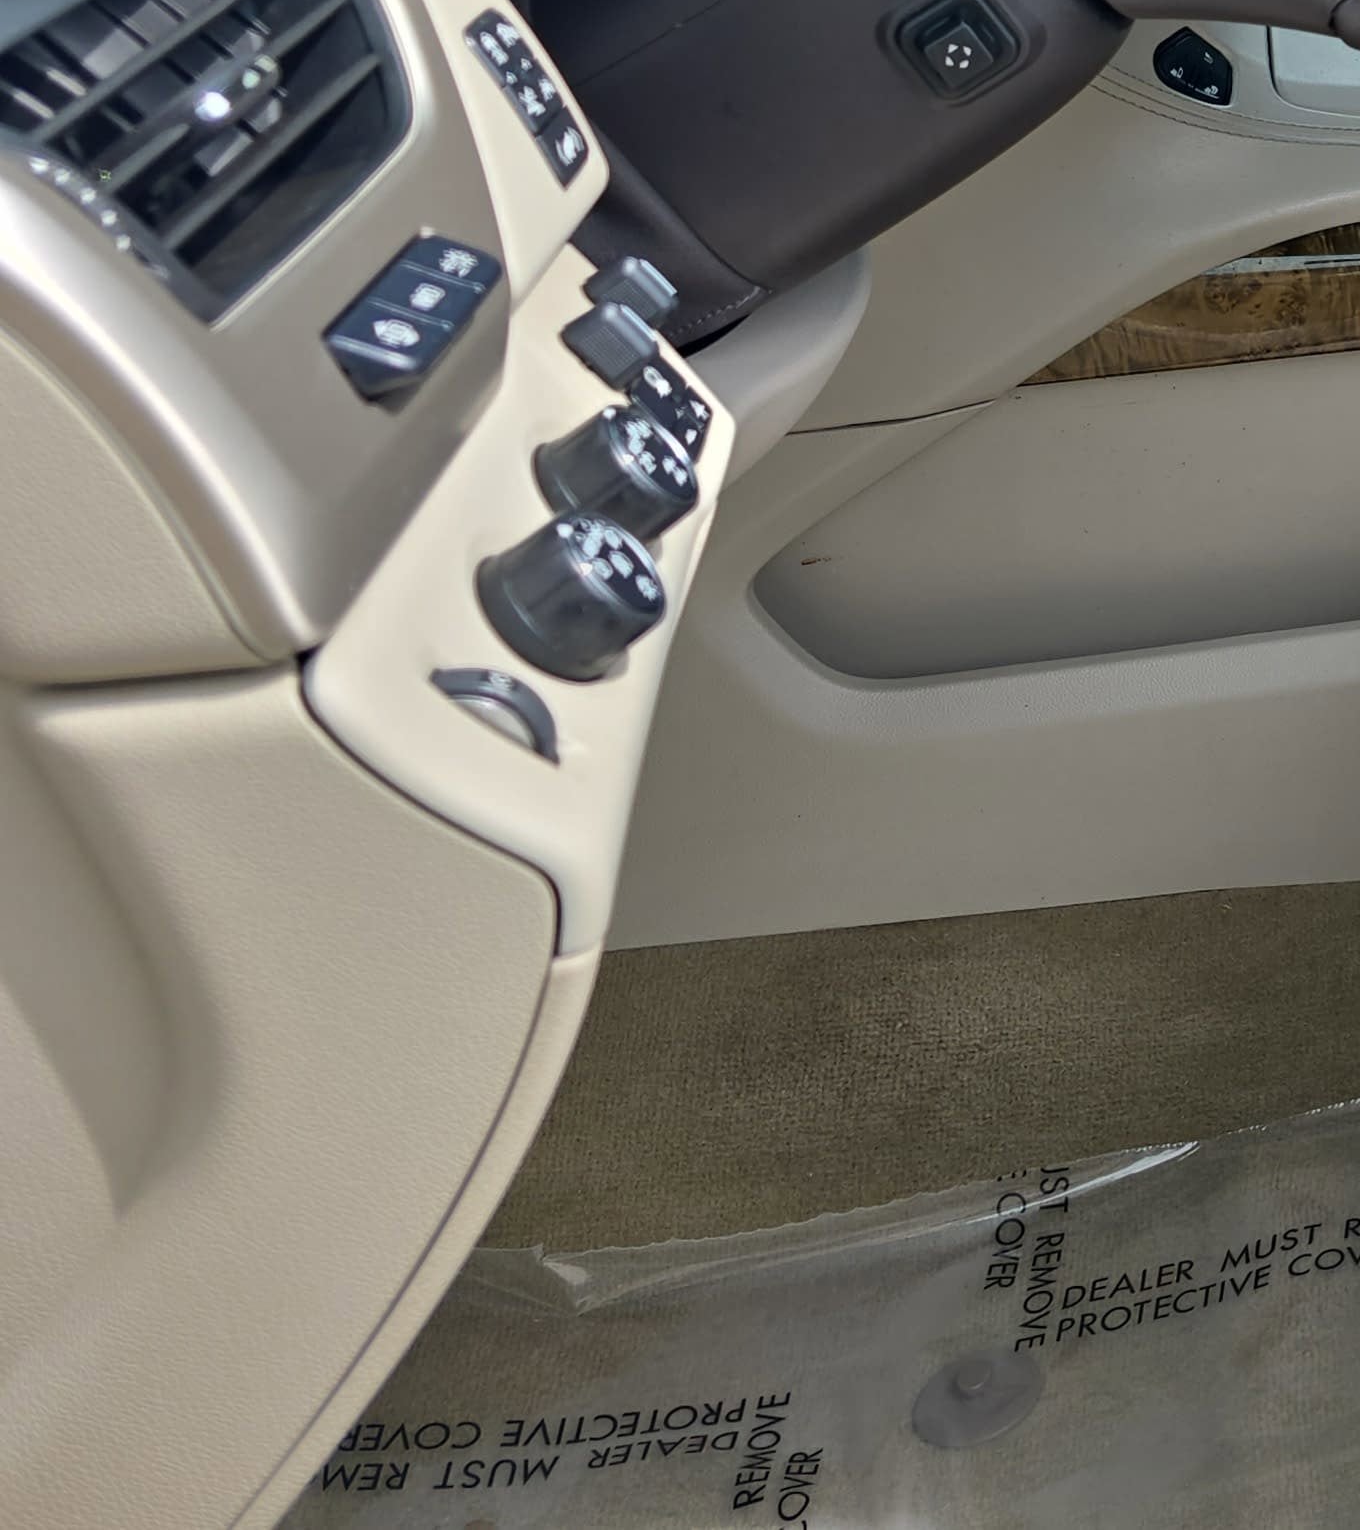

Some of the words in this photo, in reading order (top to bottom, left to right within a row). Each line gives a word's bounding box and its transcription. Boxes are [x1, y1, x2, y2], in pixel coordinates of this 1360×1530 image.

[983, 1192, 1027, 1290] COVER
[1061, 1259, 1195, 1311] DEALER
[1219, 1222, 1323, 1273] MUST
[1014, 1232, 1065, 1352] REMOVE
[1055, 1264, 1271, 1343] PROTECTIVE
[337, 1420, 482, 1452] COVER
[500, 1397, 747, 1447] PROTECTIVE
[587, 1429, 739, 1469] DEALER
[732, 1391, 791, 1510] REMOVE
[432, 1454, 560, 1491] MUST
[777, 1447, 824, 1530] OVER
